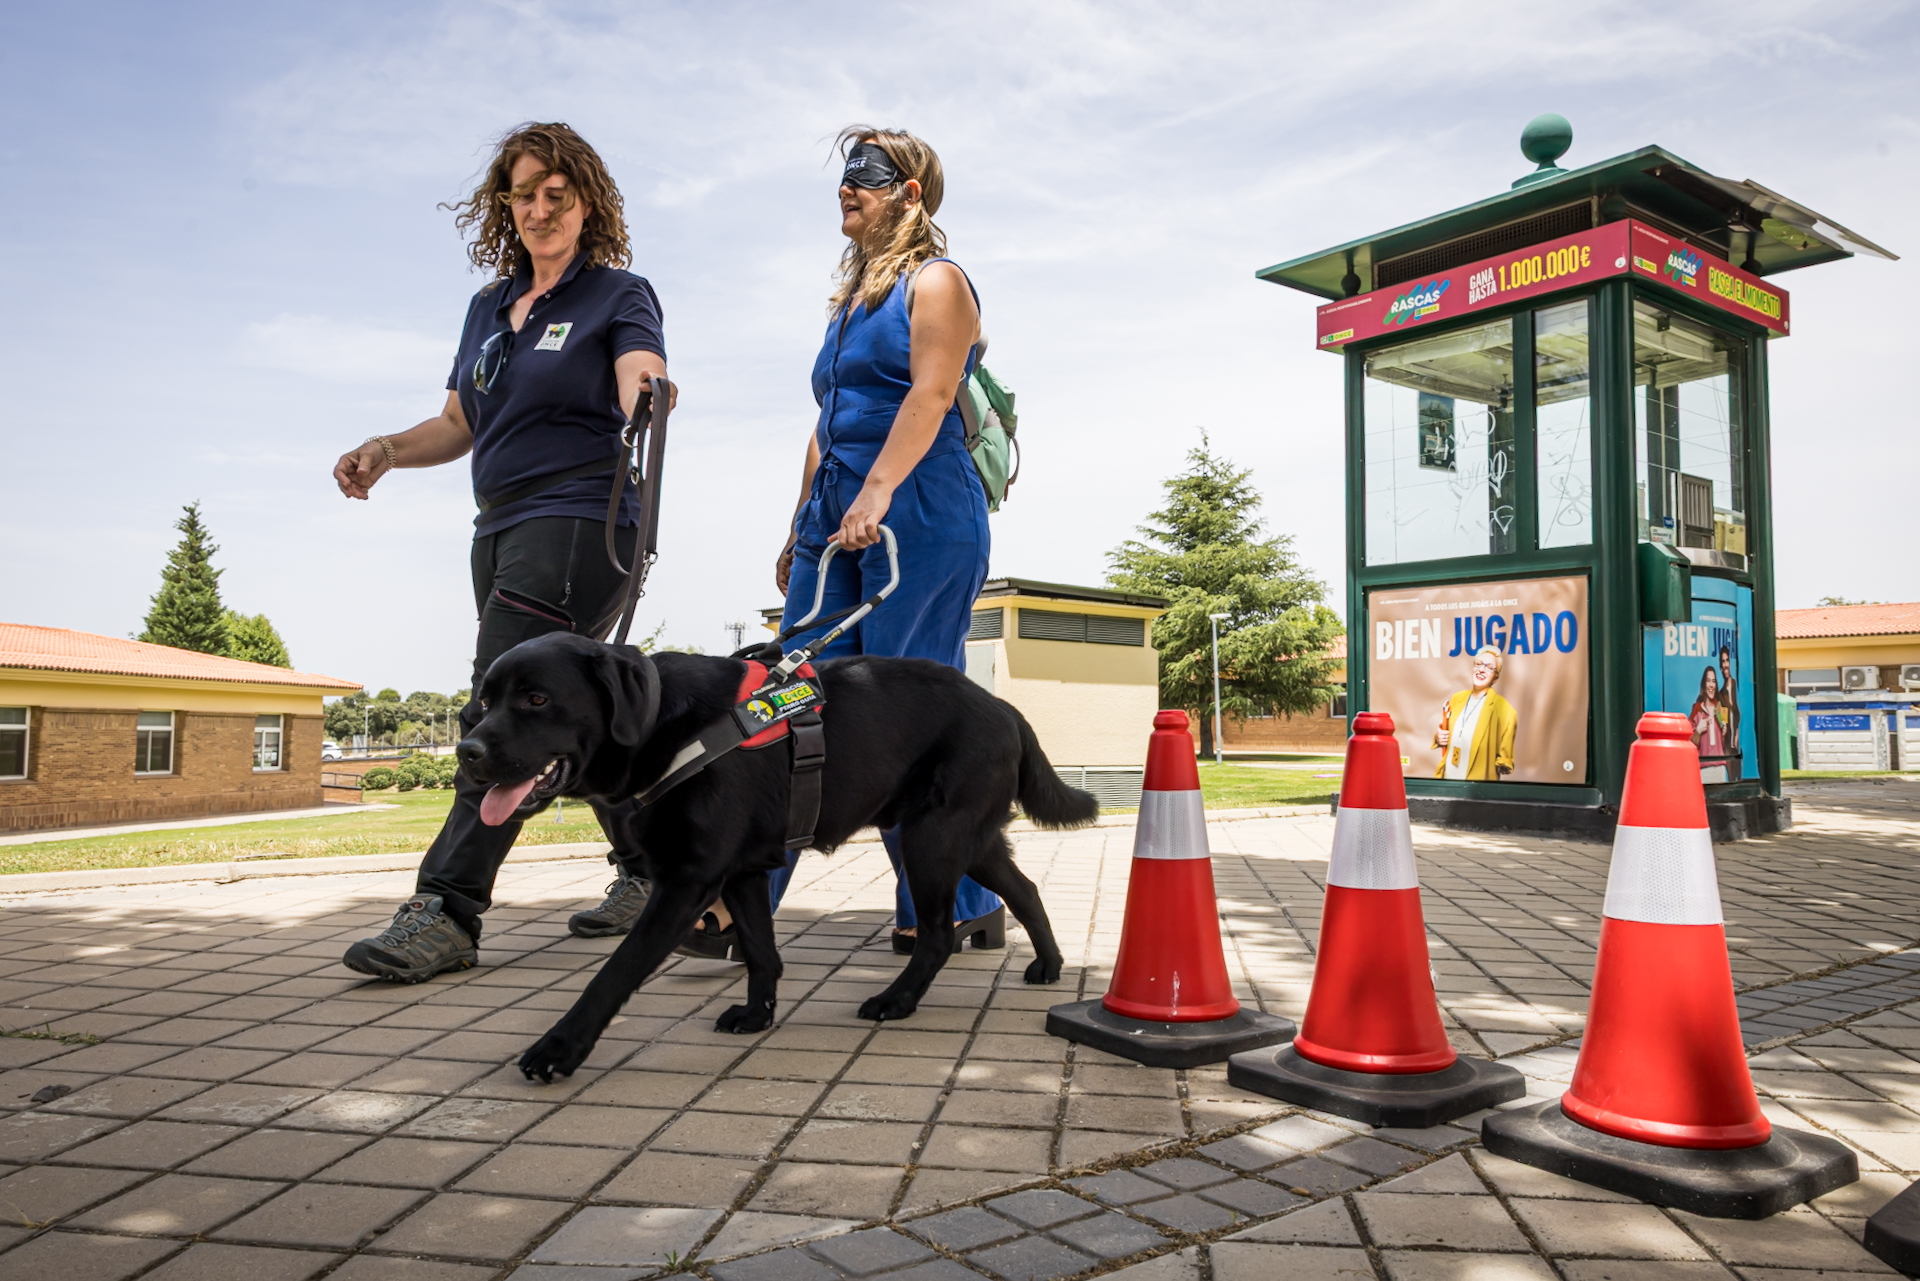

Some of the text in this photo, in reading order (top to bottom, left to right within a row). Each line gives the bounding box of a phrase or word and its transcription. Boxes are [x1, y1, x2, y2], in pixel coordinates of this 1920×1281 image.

[1499, 245, 1591, 292] 1.000.000€
[1668, 254, 1697, 277] RASCAS
[1470, 267, 1494, 290] GANA
[1391, 290, 1440, 313] RASCAS
[1469, 280, 1497, 304] HASTA
[1735, 278, 1745, 305] EL
[1335, 330, 1352, 339] ONCE
[1430, 603, 1448, 611] TODOS
[1448, 602, 1458, 610] LOS
[1503, 598, 1518, 606] ONCE
[1376, 610, 1578, 660] BIEN JUGADO
[1664, 625, 1708, 657] BIEN
[768, 681, 806, 698] FUNDACIÓN
[785, 686, 810, 701] ONCE
[779, 701, 800, 712] PERRO
